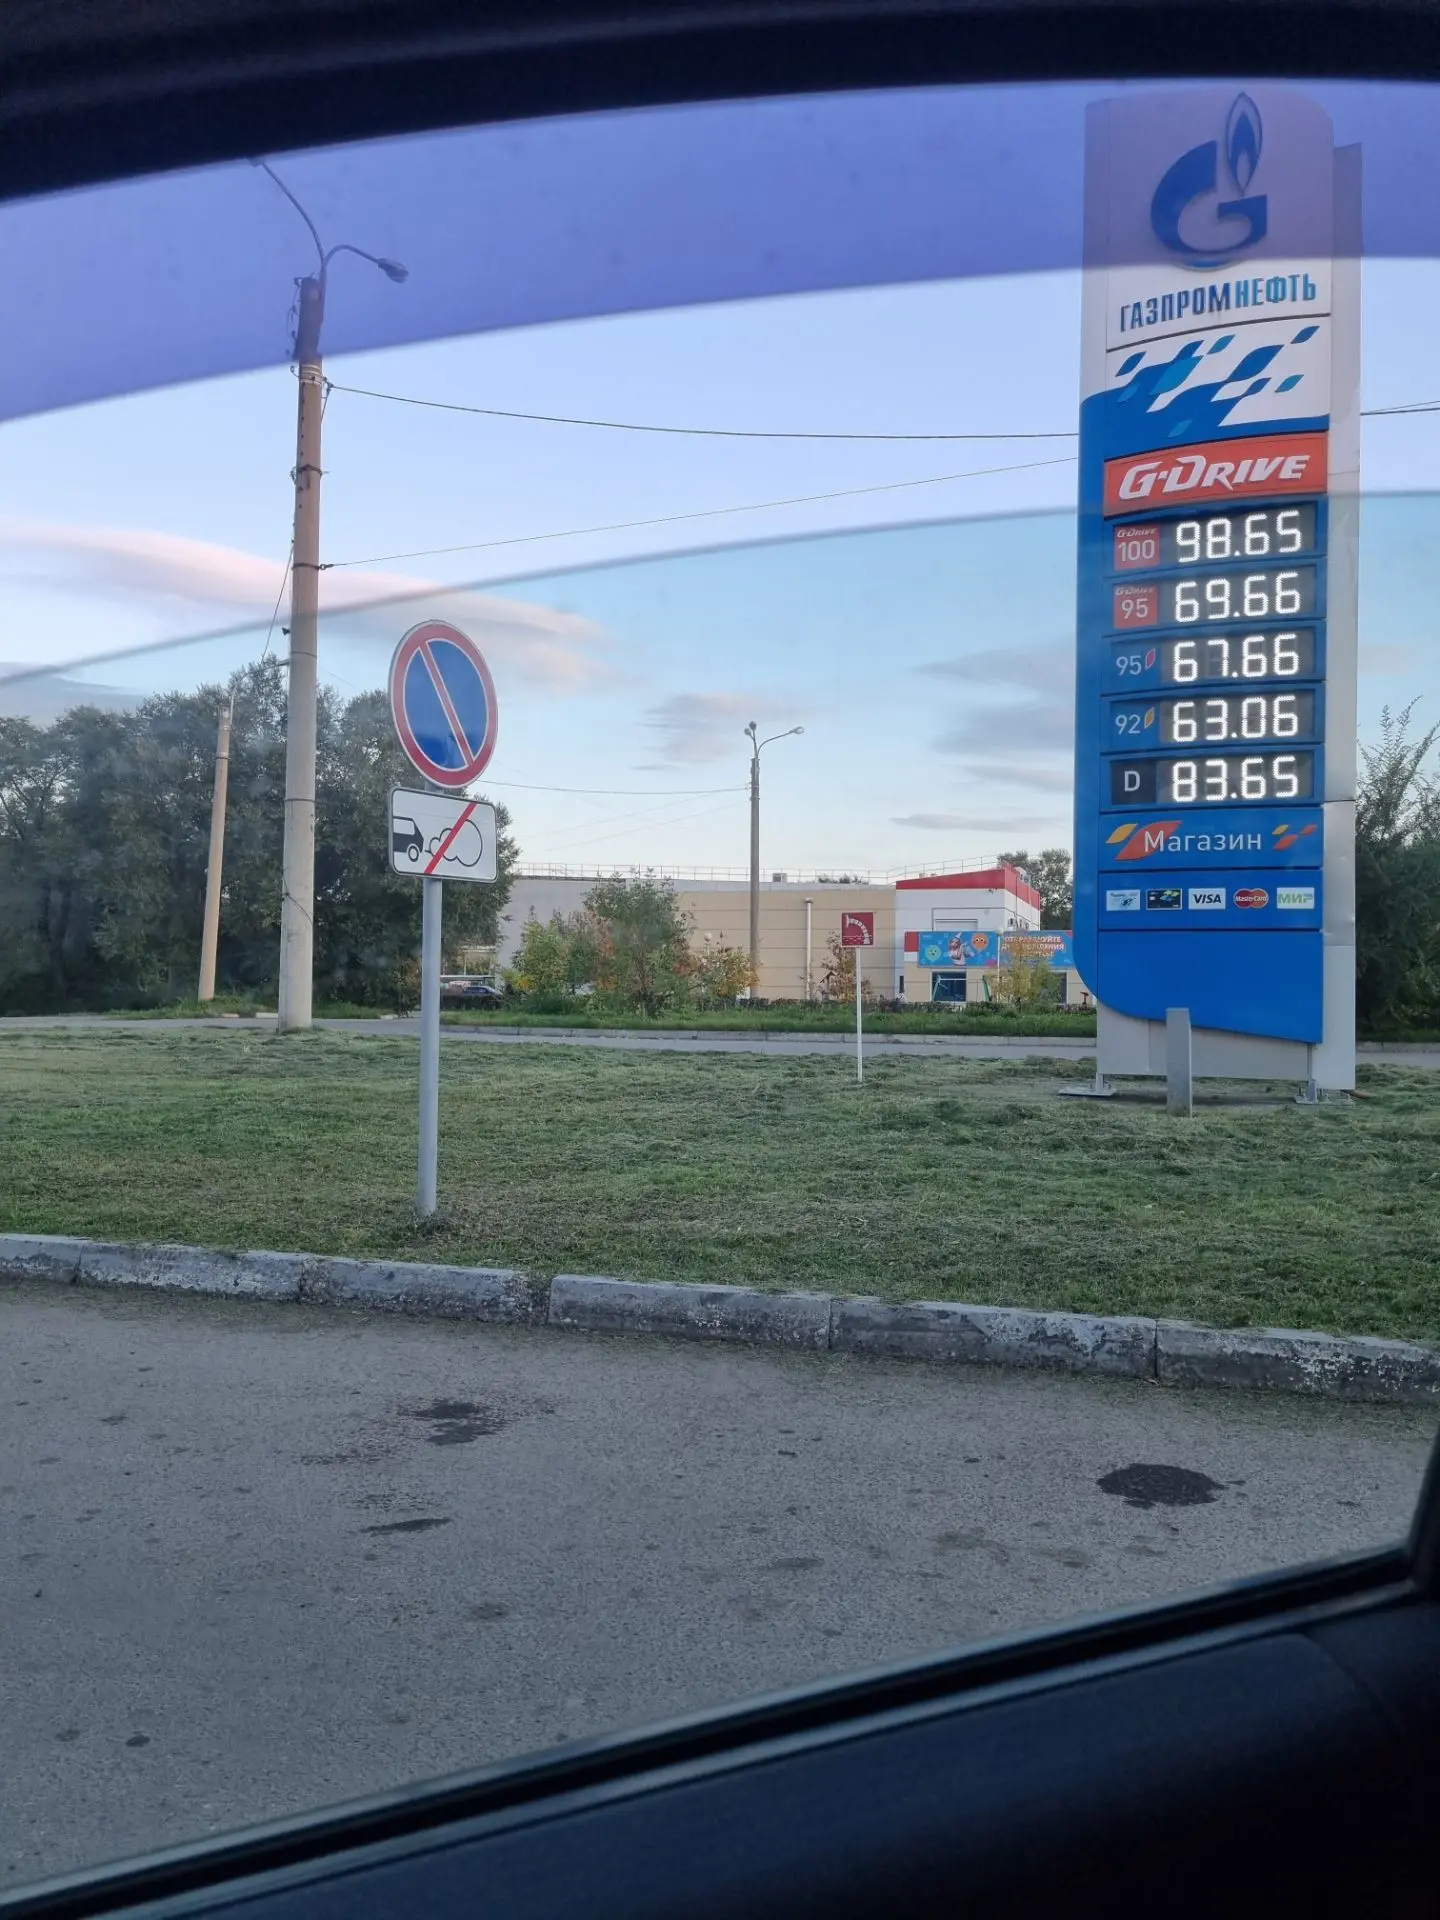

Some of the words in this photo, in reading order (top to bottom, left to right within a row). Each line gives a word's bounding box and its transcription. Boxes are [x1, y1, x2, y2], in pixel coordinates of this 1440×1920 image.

[1120, 273, 1317, 333] ГАЗПРОМНЕФТЬ
[1117, 539, 1155, 562] 100
[1175, 510, 1302, 563] 98.65
[1120, 598, 1149, 619] 95
[1174, 572, 1301, 623] 69.66
[1116, 656, 1142, 676] 95
[1173, 633, 1300, 683] 67.66
[1115, 714, 1141, 735] 92
[1172, 695, 1300, 743] 63.06
[1123, 770, 1141, 792] D
[1172, 755, 1299, 803] 83.65
[1143, 830, 1263, 853] Магазин
[1193, 893, 1222, 904] VISA
[1277, 892, 1313, 904] МИР
